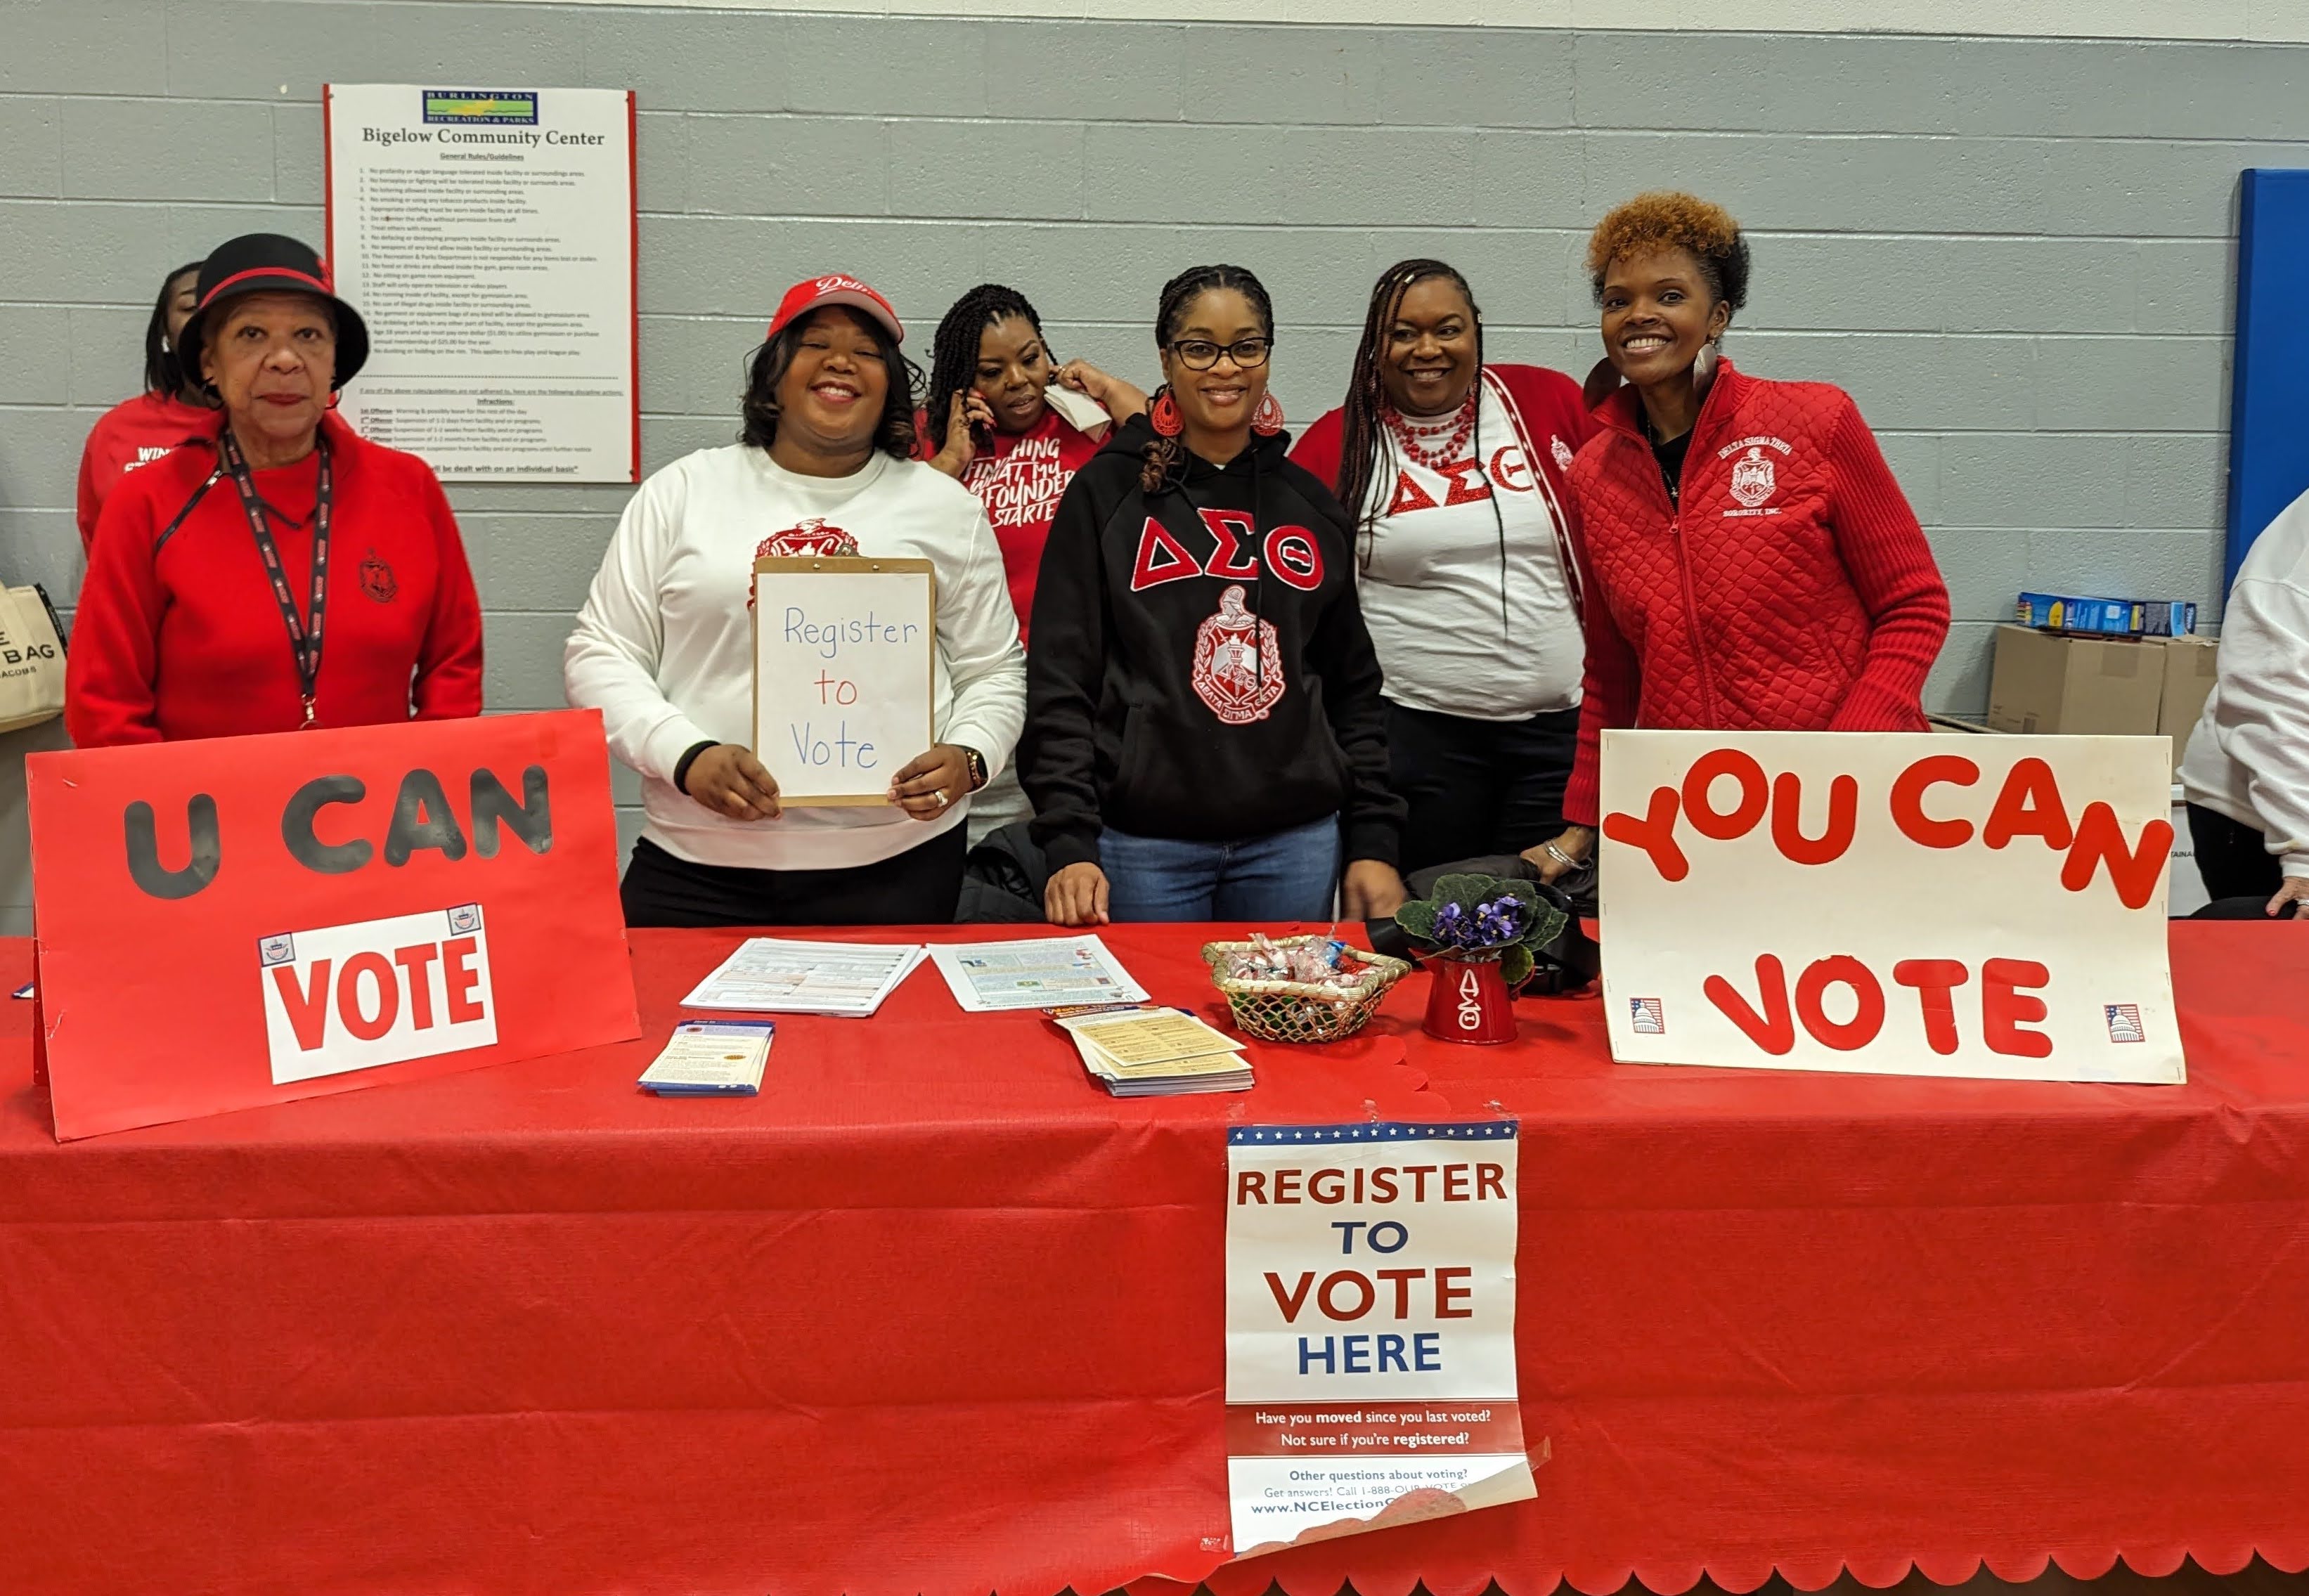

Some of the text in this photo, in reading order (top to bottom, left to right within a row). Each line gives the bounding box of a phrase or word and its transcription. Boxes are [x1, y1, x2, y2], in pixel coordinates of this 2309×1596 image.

[427, 92, 533, 100] BURLINGTON
[427, 115, 491, 124] RECREATION
[503, 116, 535, 124] PARKS
[361, 127, 605, 148] Bigelow Community Center
[469, 153, 524, 161] Rules/Guidelines
[1032, 460, 1061, 480] MY
[984, 469, 1077, 509] FOUNDER
[990, 498, 1061, 528] STARTE
[784, 606, 917, 658] Register
[3, 643, 55, 664] BAG
[0, 665, 37, 679] ACOBS
[813, 669, 858, 705] to
[791, 720, 878, 769] Vote
[124, 763, 555, 900] U CAN
[1600, 747, 2174, 910] YOU CAN
[271, 935, 485, 1051] VOTE
[1702, 952, 2053, 1059] VOTE
[1236, 1162, 1508, 1206] REGISTER
[1331, 1220, 1409, 1254] TO
[1262, 1266, 1473, 1323] VOTE
[1298, 1332, 1442, 1375] HERE
[1255, 1410, 1492, 1427] Have you moved since you last voted?
[1281, 1432, 1470, 1449] Not sure if you're registered?
[1288, 1468, 1468, 1483] Other questions about voting?
[1250, 1498, 1395, 1514] www.NCElectionC
[1264, 1487, 1286, 1498] Get
[1288, 1486, 1333, 1498] answers!
[1336, 1486, 1357, 1497] Call
